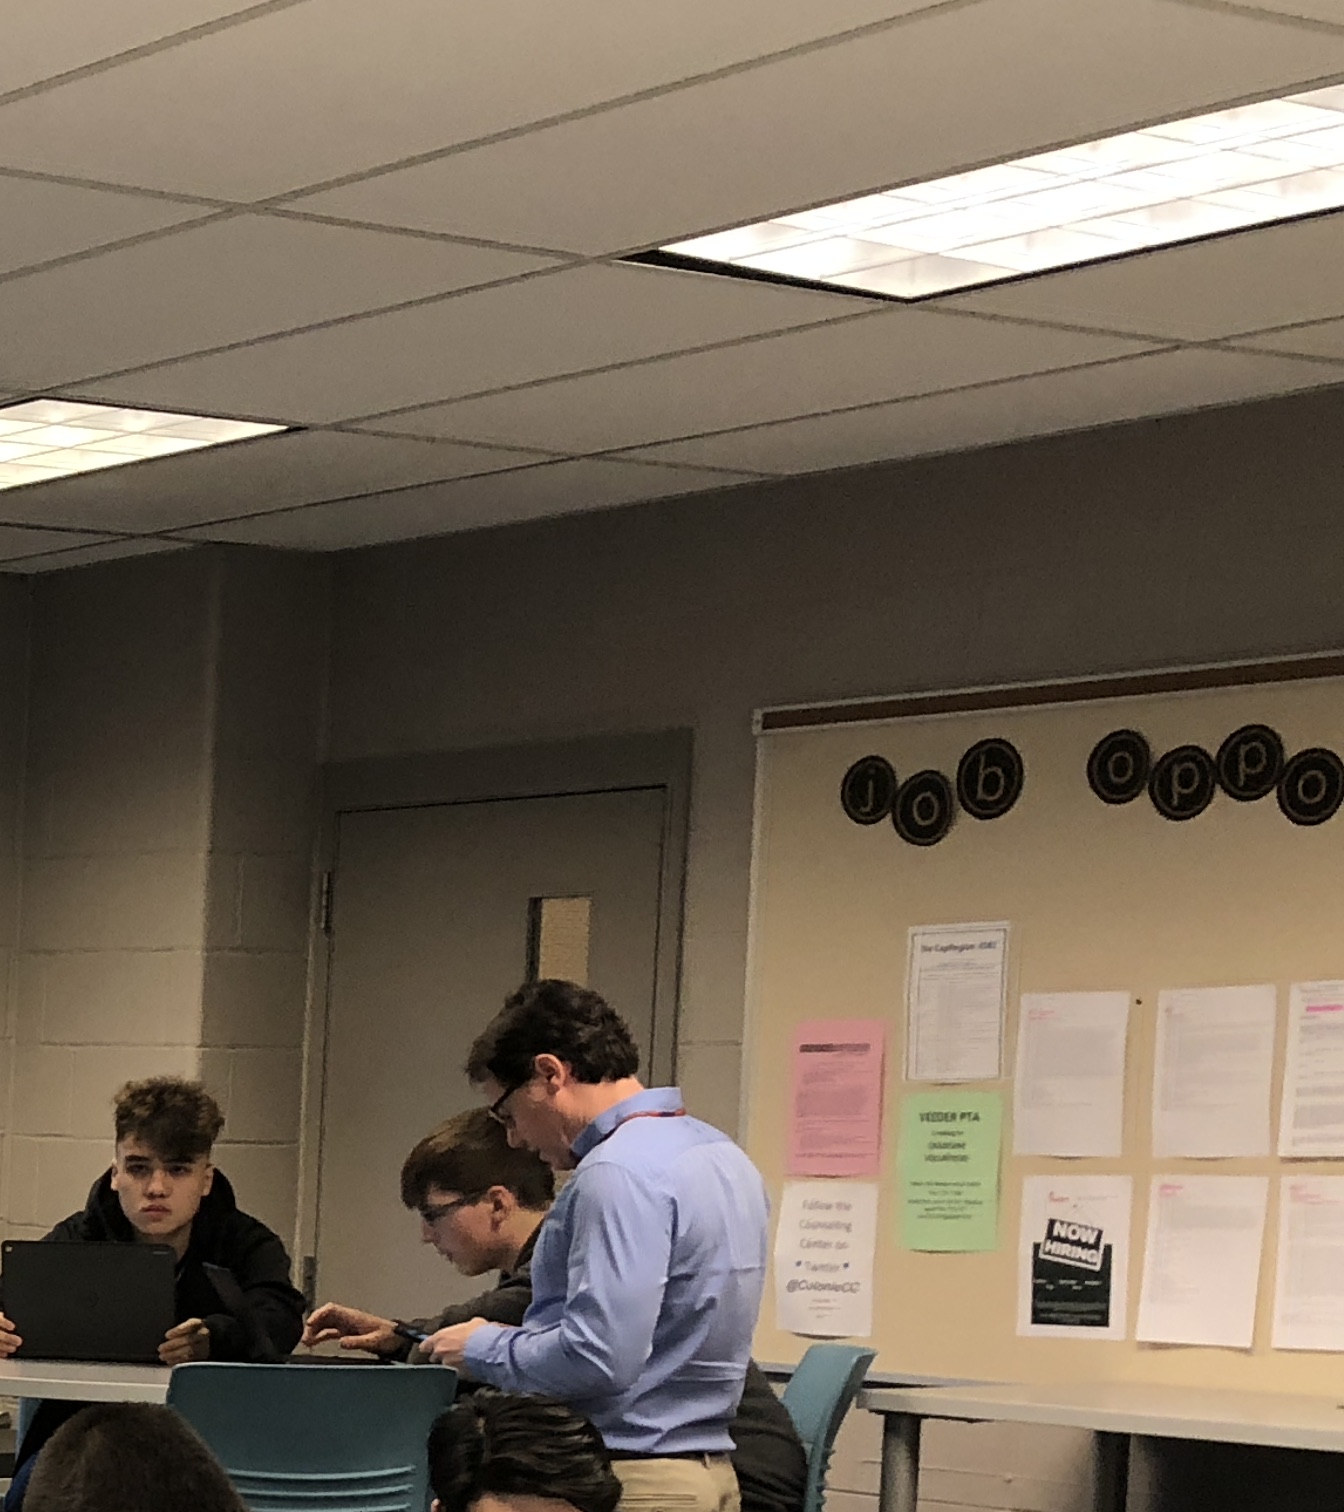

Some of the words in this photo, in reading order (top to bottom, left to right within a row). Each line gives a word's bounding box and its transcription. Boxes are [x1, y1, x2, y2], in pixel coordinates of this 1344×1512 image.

[860, 752, 1006, 827] job
[1053, 1221, 1099, 1245] NOW
[1044, 1239, 1100, 1264] HIRING
